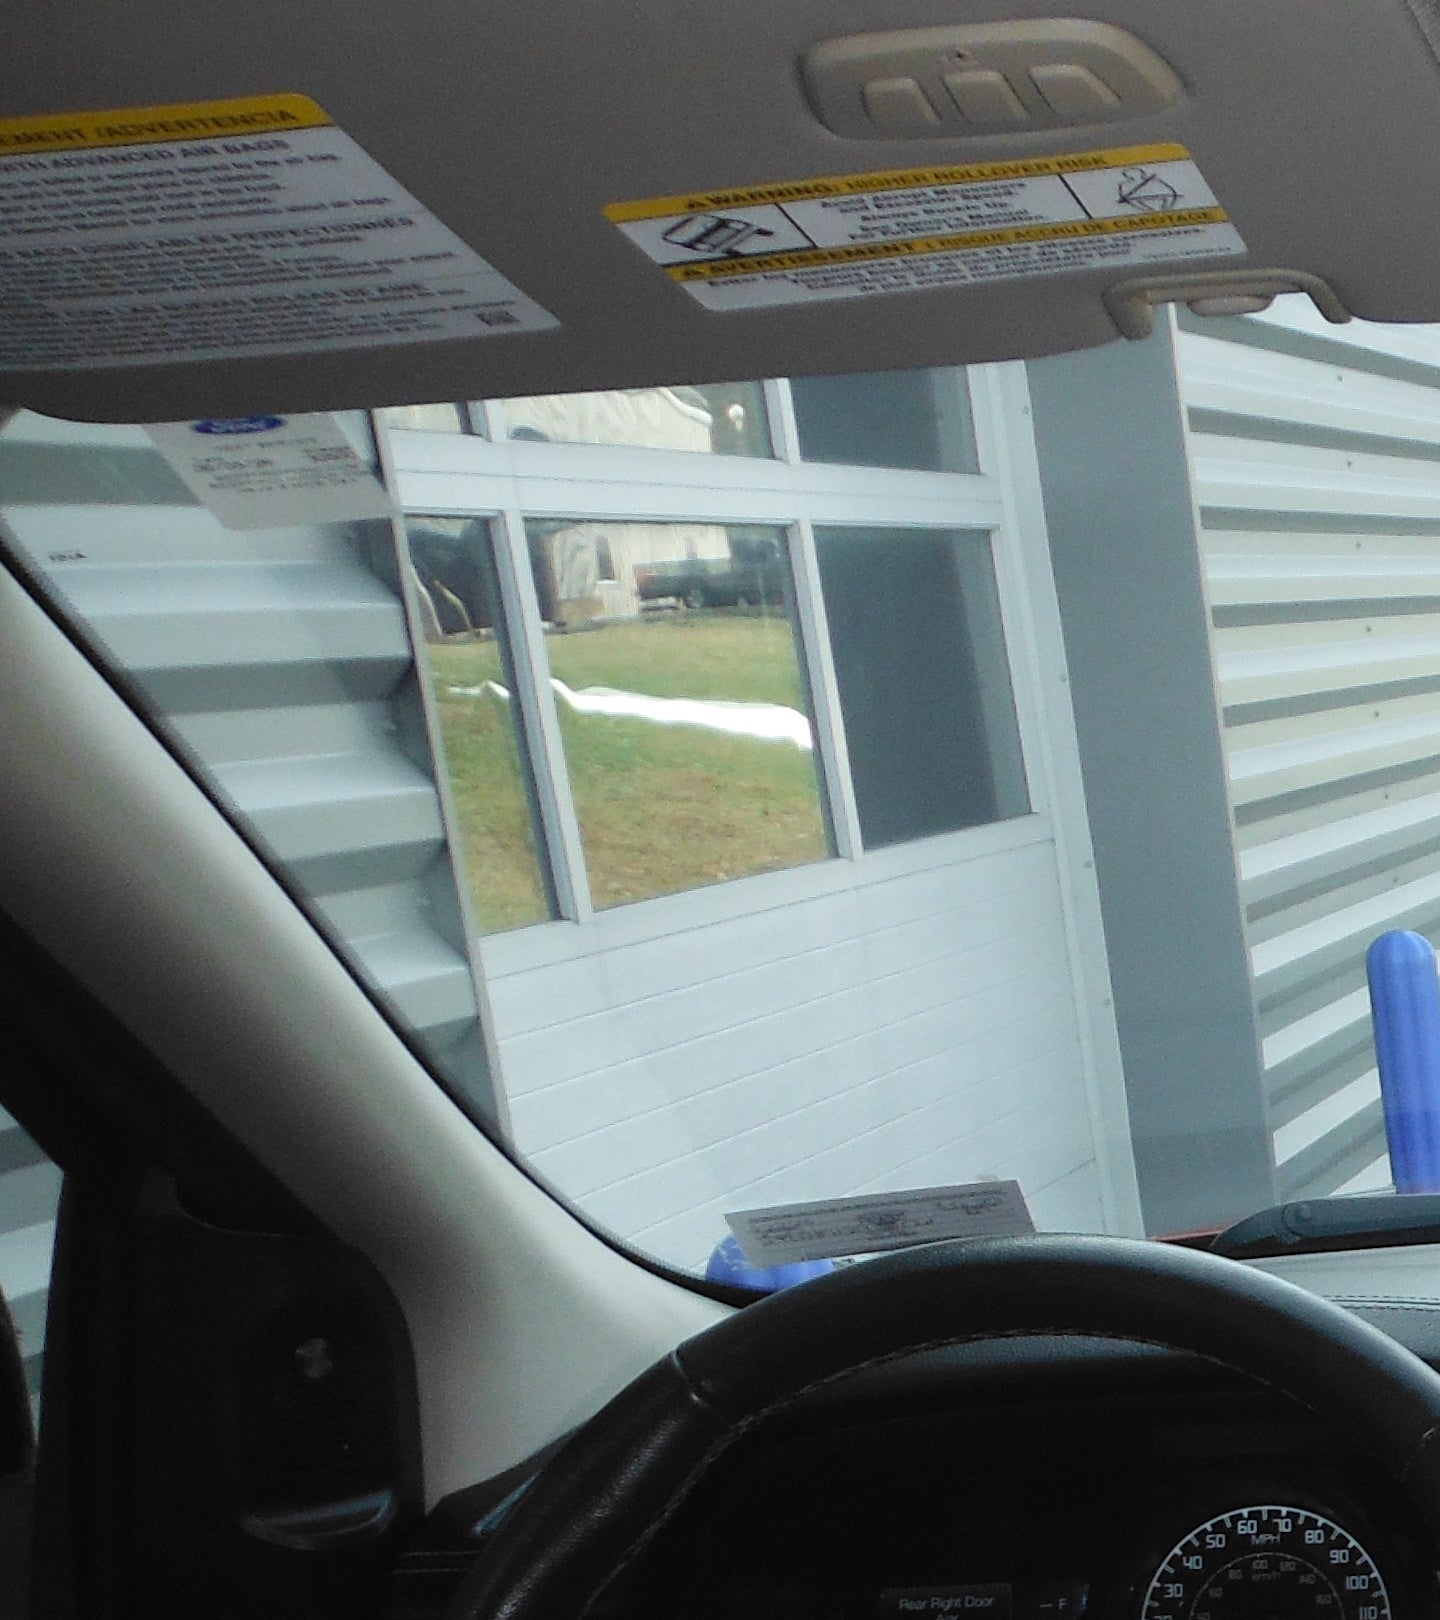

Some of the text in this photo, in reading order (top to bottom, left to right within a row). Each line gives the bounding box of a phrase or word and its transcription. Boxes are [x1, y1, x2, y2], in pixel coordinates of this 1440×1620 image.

[1237, 1518, 1258, 1535] 60
[1273, 1518, 1292, 1533] 70
[1205, 1533, 1226, 1548] 50
[1251, 1534, 1281, 1546] MPH
[1305, 1529, 1325, 1545] 80
[1183, 1555, 1203, 1570] 40
[1329, 1549, 1350, 1564] 90
[1345, 1574, 1369, 1590] 100
[1164, 1583, 1184, 1598] 30
[899, 1595, 994, 1611] Rear Right Door
[1058, 1599, 1067, 1610] F
[1360, 1606, 1378, 1620] 110
